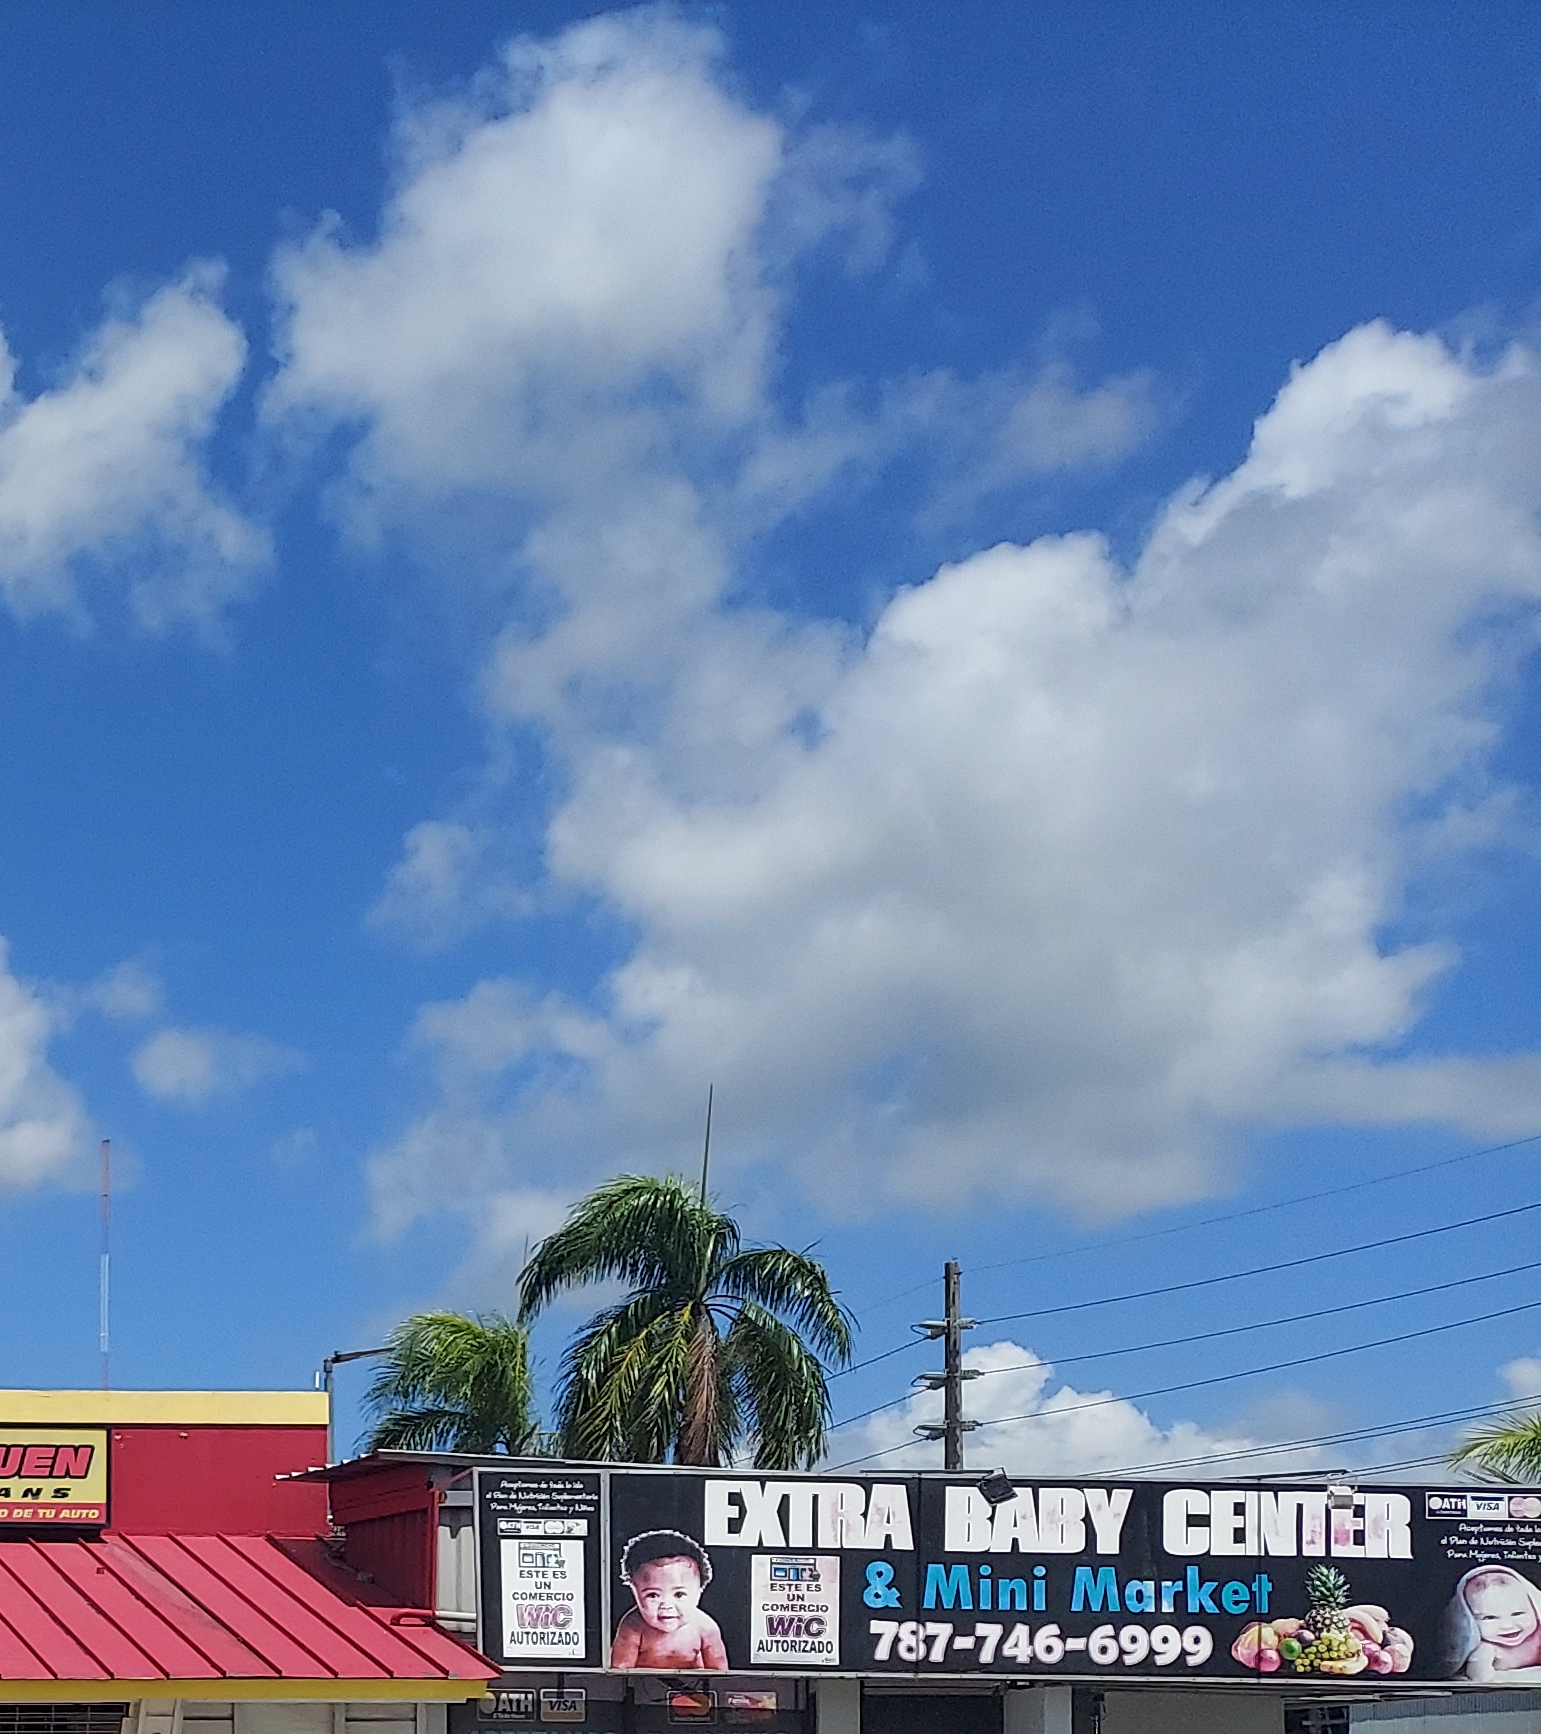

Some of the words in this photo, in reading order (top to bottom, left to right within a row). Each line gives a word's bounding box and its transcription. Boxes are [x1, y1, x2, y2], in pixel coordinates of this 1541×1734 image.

[1441, 1497, 1466, 1510] ATH
[1476, 1502, 1500, 1511] VISA
[12, 1508, 33, 1518] DE
[38, 1509, 55, 1519] TU
[59, 1509, 100, 1519] AUTO
[704, 1479, 915, 1551] EXTRA
[944, 1485, 1134, 1555] BABY
[1163, 1488, 1414, 1559] CENTER
[518, 1570, 549, 1579] ESTE
[552, 1570, 567, 1579] ES
[534, 1581, 551, 1590] UN
[770, 1583, 802, 1592] ESTE
[806, 1583, 822, 1592] ES
[863, 1560, 902, 1609] &
[922, 1563, 1047, 1611] Mini
[1070, 1565, 1273, 1615] Market
[511, 1592, 574, 1601] COMERCIO
[786, 1593, 805, 1602] UN
[761, 1603, 829, 1613] COMERCIO
[509, 1631, 579, 1646] AUTORIZADO
[869, 1619, 1214, 1667] 787-746-6999
[756, 1639, 834, 1654] AUTORIZADO
[498, 1692, 533, 1712] ATH
[548, 1699, 578, 1711] VISA
